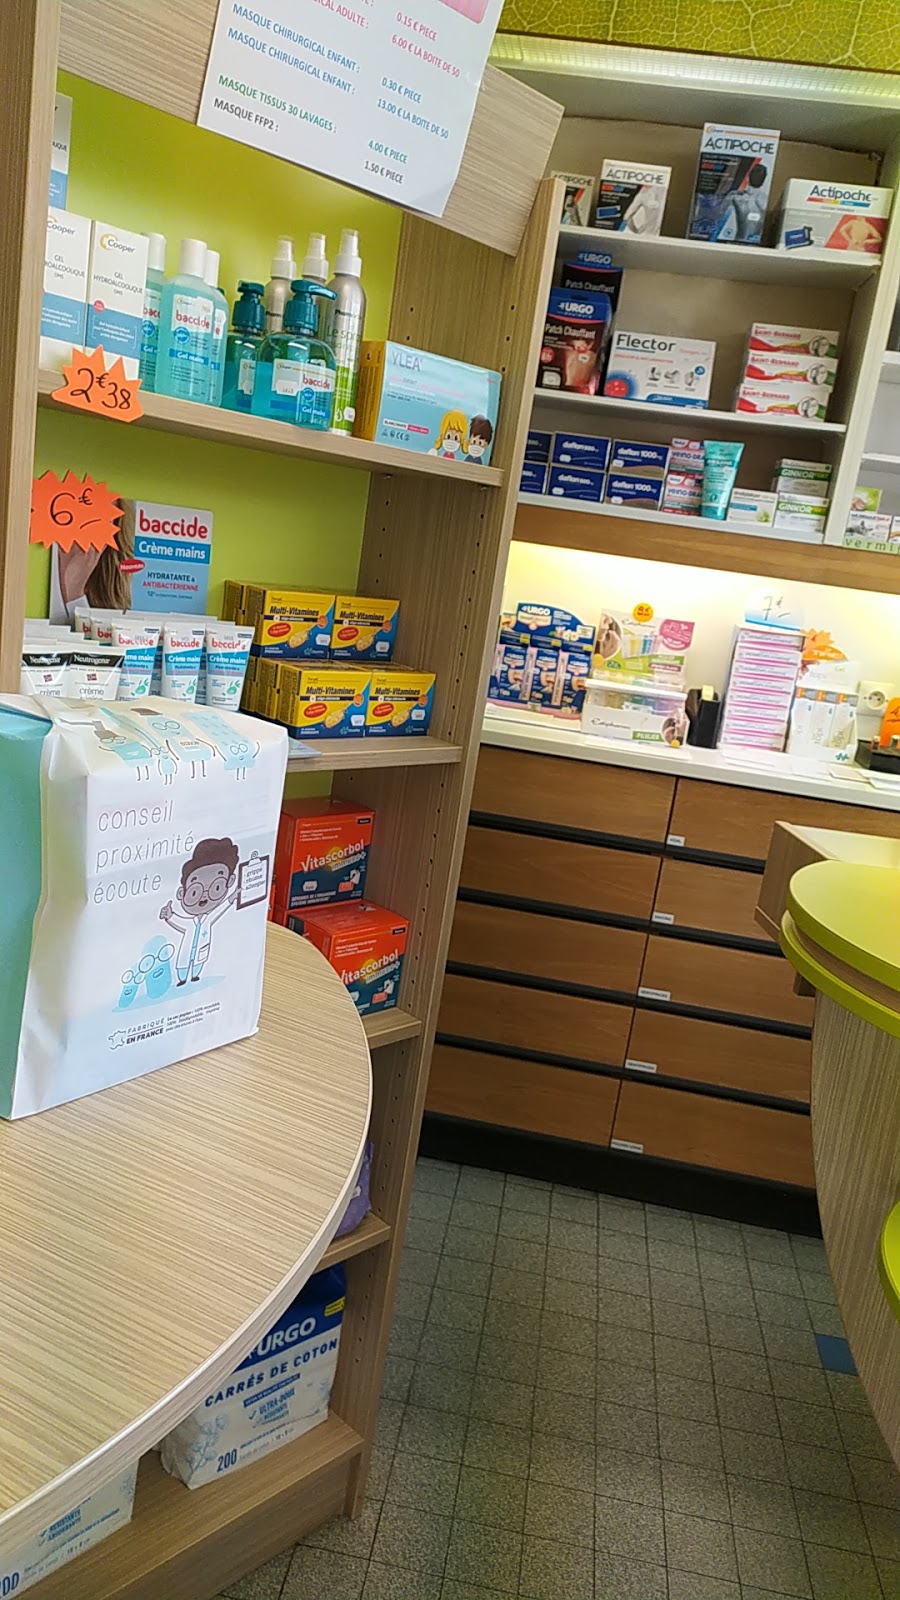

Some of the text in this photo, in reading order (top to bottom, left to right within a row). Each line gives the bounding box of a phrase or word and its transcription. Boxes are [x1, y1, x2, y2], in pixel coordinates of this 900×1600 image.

[336, 4, 365, 27] ADULTE
[396, 12, 412, 28] 0.15
[418, 24, 437, 42] PIECE
[232, 3, 357, 72] MASQUE CHIRURGICAL ENFANT
[228, 27, 352, 93] MASQUE CHIRURGICAL ENFANT
[392, 34, 407, 50] 6.00
[413, 46, 422, 58] LA
[423, 51, 442, 68] BOITE
[442, 61, 451, 73] DE
[451, 66, 461, 78] 50
[381, 77, 397, 92] 0.30
[403, 88, 422, 104] PIECE
[218, 75, 333, 132] MASQUE TISSUS 30 LAVAGES
[213, 97, 274, 131] MASQUE FFP2
[377, 98, 397, 115] 13.00
[402, 108, 411, 121] LA
[411, 113, 430, 131] BOITE
[430, 122, 440, 135] DE
[440, 129, 449, 139] 50
[367, 140, 384, 154] 4.00
[389, 149, 408, 164] PIECE
[704, 137, 775, 155] ACTIPOCHE
[364, 161, 379, 175] 1.50
[385, 169, 404, 185] PIECE
[606, 168, 665, 184] ACTIPOCHE
[809, 184, 872, 202] Actipoche
[46, 220, 76, 236] Cooper
[107, 238, 136, 254] Cooper
[583, 252, 612, 265] URGO
[564, 302, 595, 315] URGO
[175, 309, 210, 329] baccide
[545, 322, 596, 339] Patch Chauffant
[615, 333, 677, 352] Flector
[391, 350, 421, 372] YLEA
[302, 373, 330, 390] baccide
[618, 447, 640, 457] daflon
[641, 451, 657, 460] 1000
[781, 468, 815, 479] GINKOR
[612, 481, 634, 490] daflon
[635, 483, 651, 493] 1000
[778, 502, 812, 514] GINKOR
[139, 509, 208, 539] baccide
[138, 540, 206, 560] Crème mains
[147, 571, 191, 583] HYDRATANTE
[269, 605, 320, 617] Multi-Vitamines
[339, 610, 385, 622] Multi-Vitamines
[526, 606, 551, 616] URGO
[170, 637, 200, 648] baccide
[74, 654, 111, 665] Neutrogena
[79, 686, 105, 697] crème
[305, 686, 356, 696] Multi-Vitamines
[374, 687, 421, 696] Multi-Vitamines
[98, 800, 174, 832] conseil
[96, 831, 194, 874] proximité
[301, 839, 365, 874] Vitascorbol
[94, 875, 162, 904] écoute
[126, 1028, 164, 1045] EN FRANCE
[256, 1317, 317, 1356] URGO
[204, 1374, 265, 1408] CARRÉS
[270, 1361, 289, 1378] DE
[293, 1338, 338, 1368] COTON
[216, 1448, 237, 1472] 200
